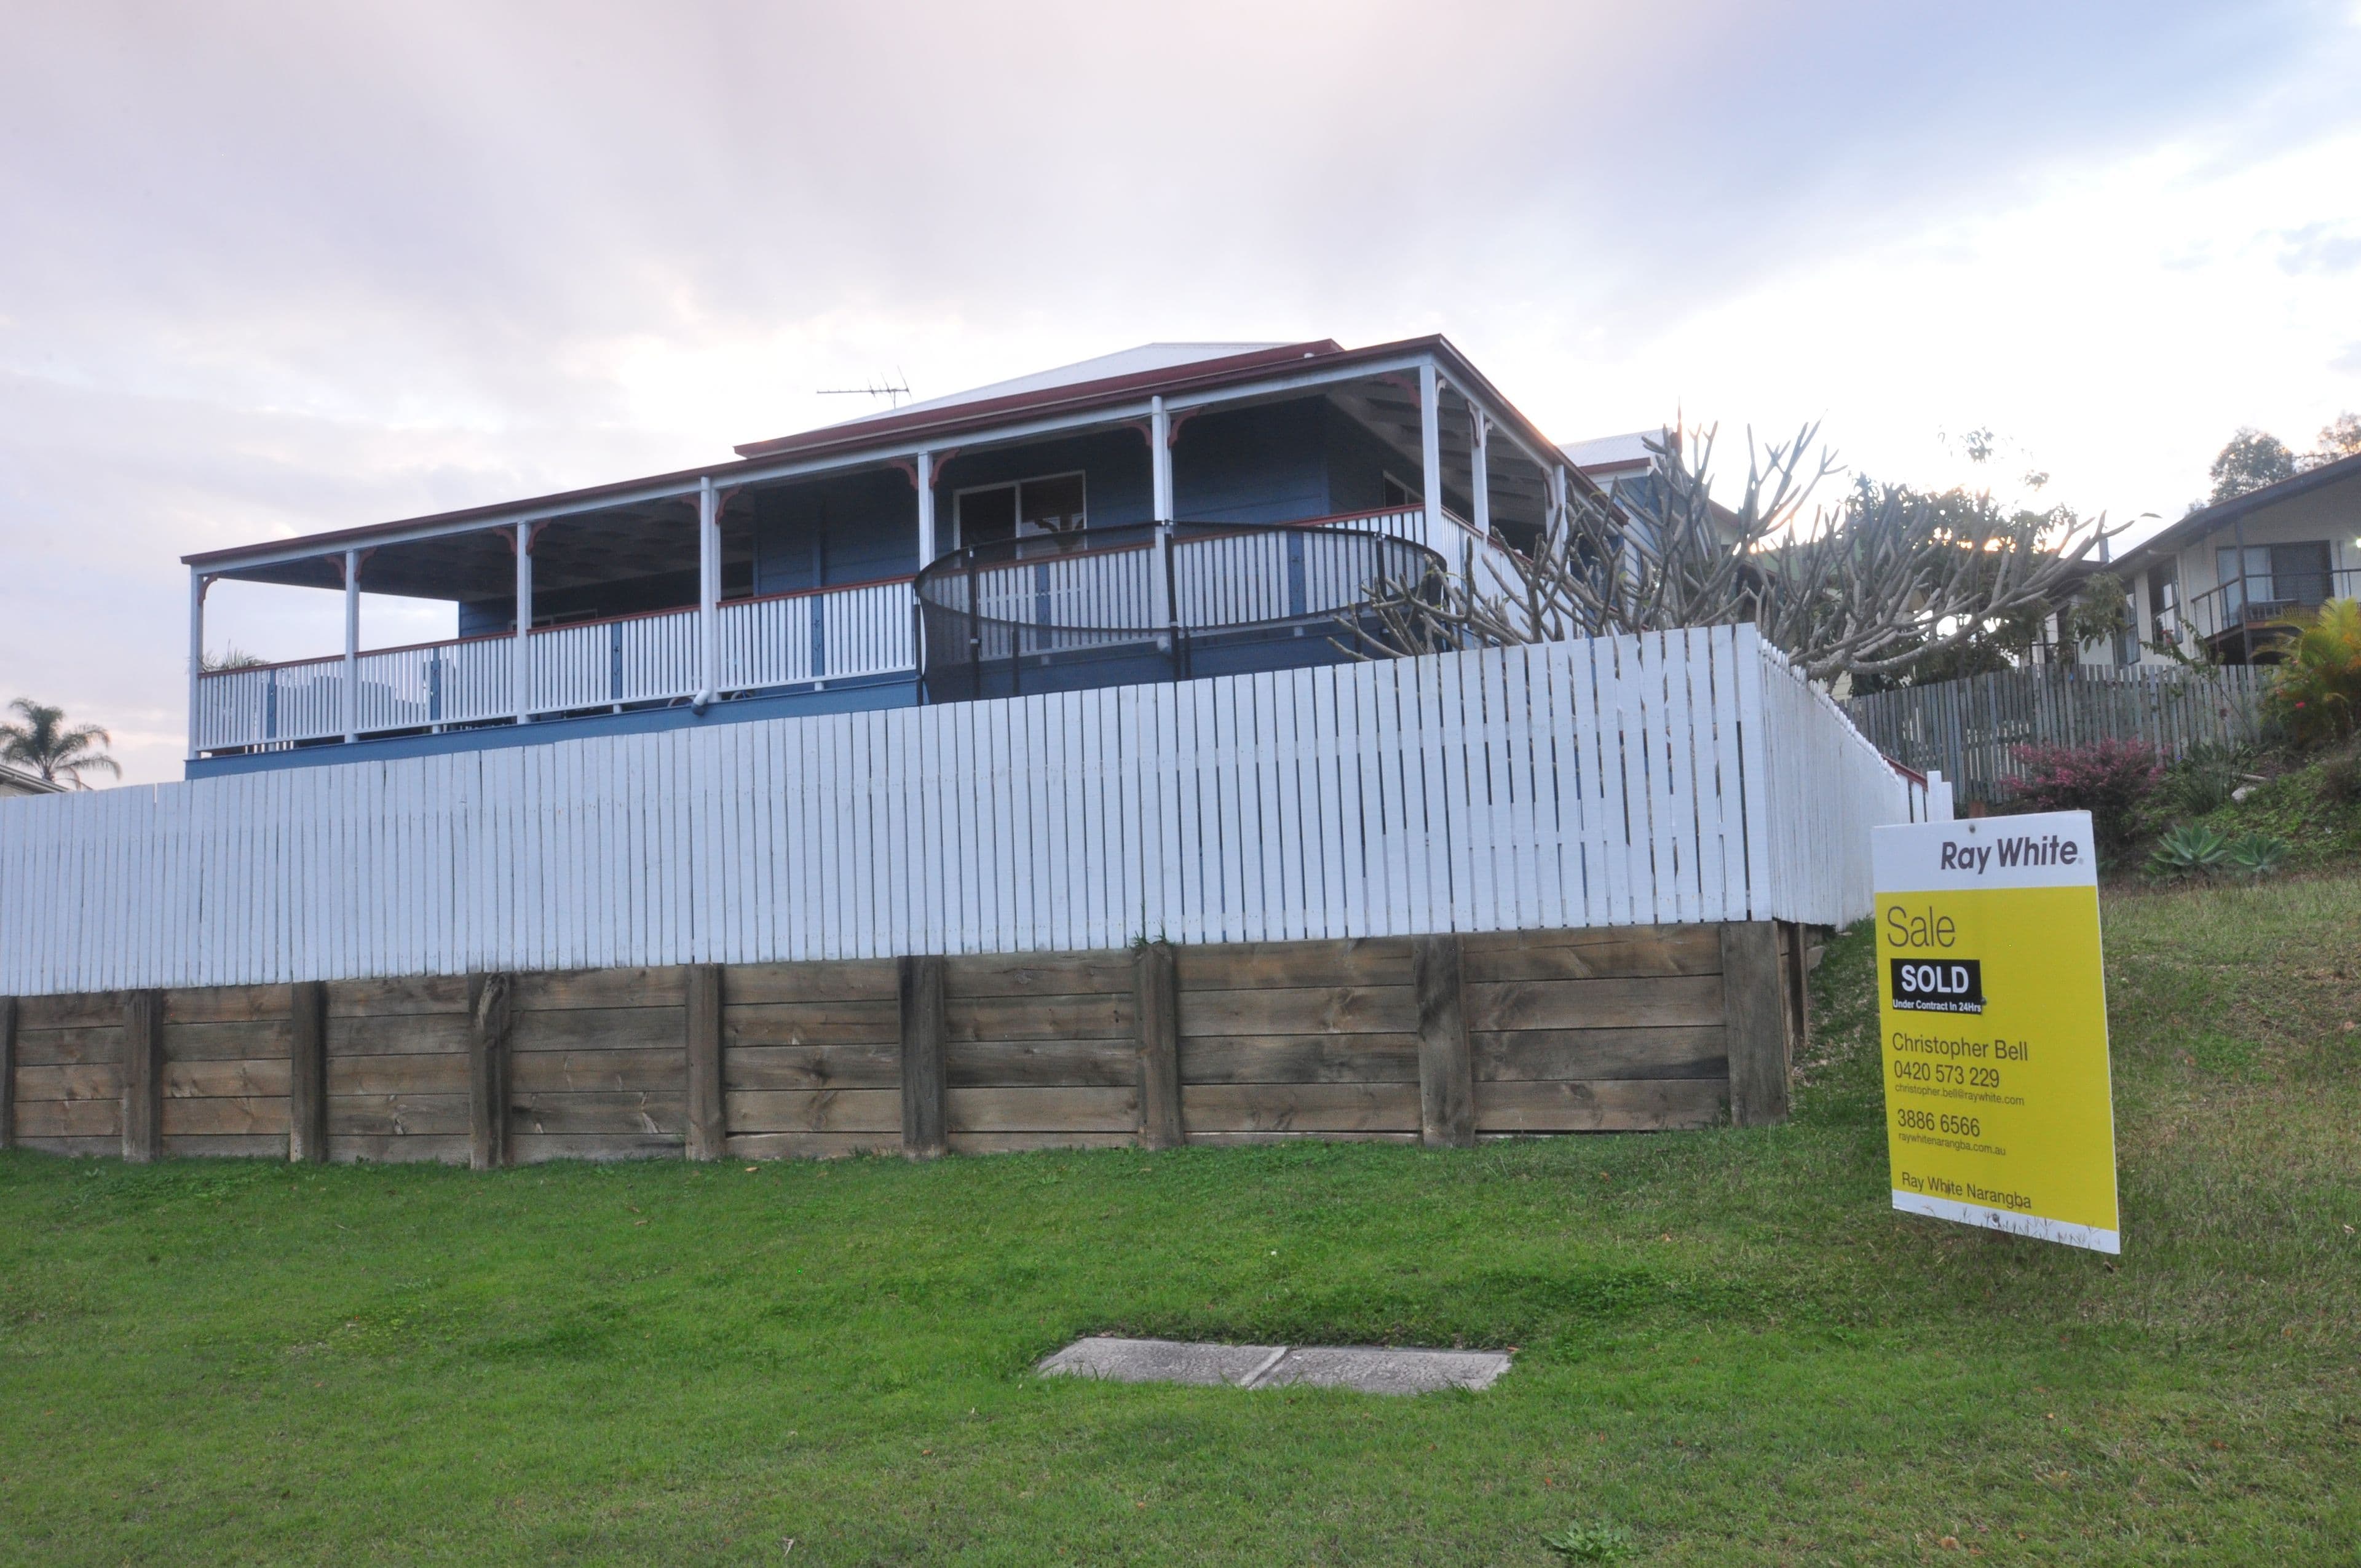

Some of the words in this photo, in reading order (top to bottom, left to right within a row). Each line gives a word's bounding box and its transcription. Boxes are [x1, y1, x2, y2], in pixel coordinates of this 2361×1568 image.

[1940, 841, 1991, 874] Ray
[1887, 906, 1956, 947] Sale
[1901, 965, 1969, 994] SOLD
[1893, 999, 1915, 1010] Under
[1916, 1000, 1948, 1011] Contract
[1958, 1002, 1982, 1013] 24Hrs
[1892, 1032, 1989, 1060] Christopher
[1995, 1039, 2029, 1061] Bell
[1894, 1060, 1931, 1081] 0420
[1936, 1064, 1964, 1085] 573
[1970, 1067, 1999, 1088] 229
[1895, 1084, 2025, 1106] christopher.bell@raywhite.com
[1897, 1109, 1935, 1131] 3886
[1940, 1114, 1980, 1137] 6566
[1899, 1132, 2006, 1156] raywhitenarangba.com.au
[1902, 1172, 1924, 1191] Ray
[1928, 1176, 1963, 1196] White
[1968, 1184, 2031, 1209] Narangba
